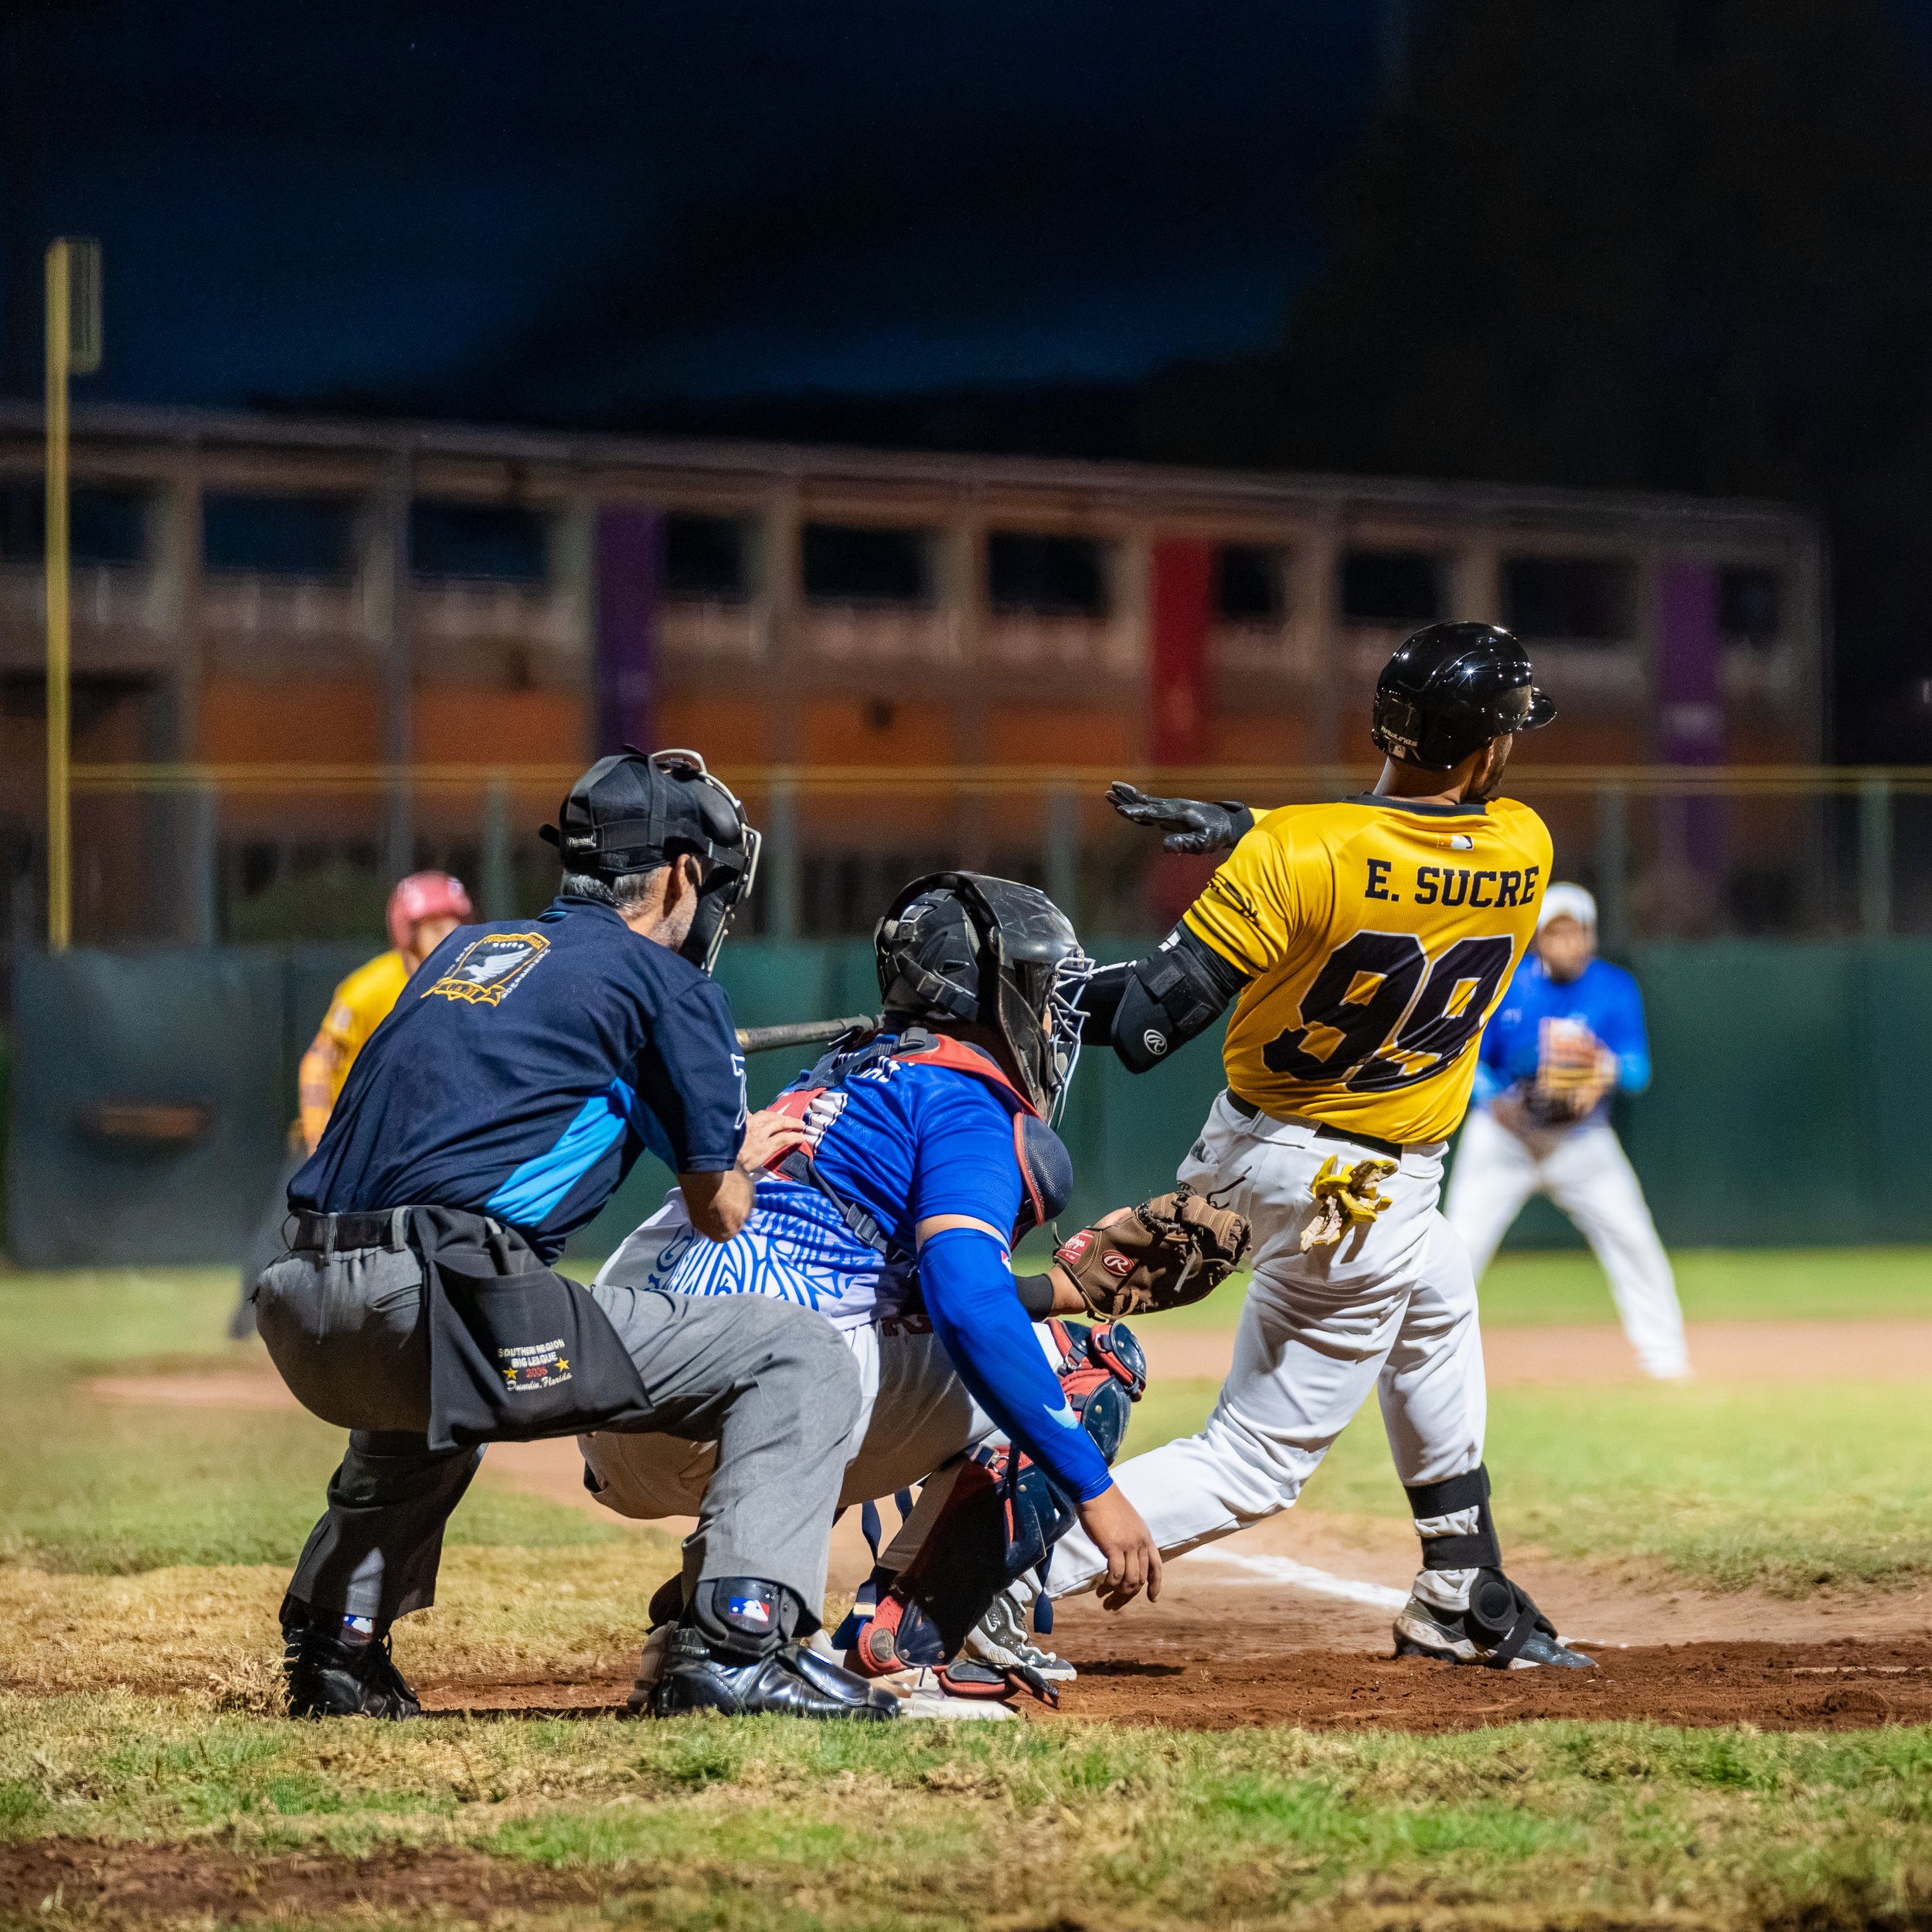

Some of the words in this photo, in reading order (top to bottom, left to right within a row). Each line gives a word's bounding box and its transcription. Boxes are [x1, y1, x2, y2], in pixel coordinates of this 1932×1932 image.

[1365, 858, 1400, 902] E.
[1414, 865, 1539, 908] SUCRE
[1260, 929, 1515, 1094] 99
[536, 1338, 565, 1354] REGION
[511, 1357, 528, 1369] BIG
[527, 1351, 558, 1367] LEAGUE
[541, 1372, 572, 1388] Florida
